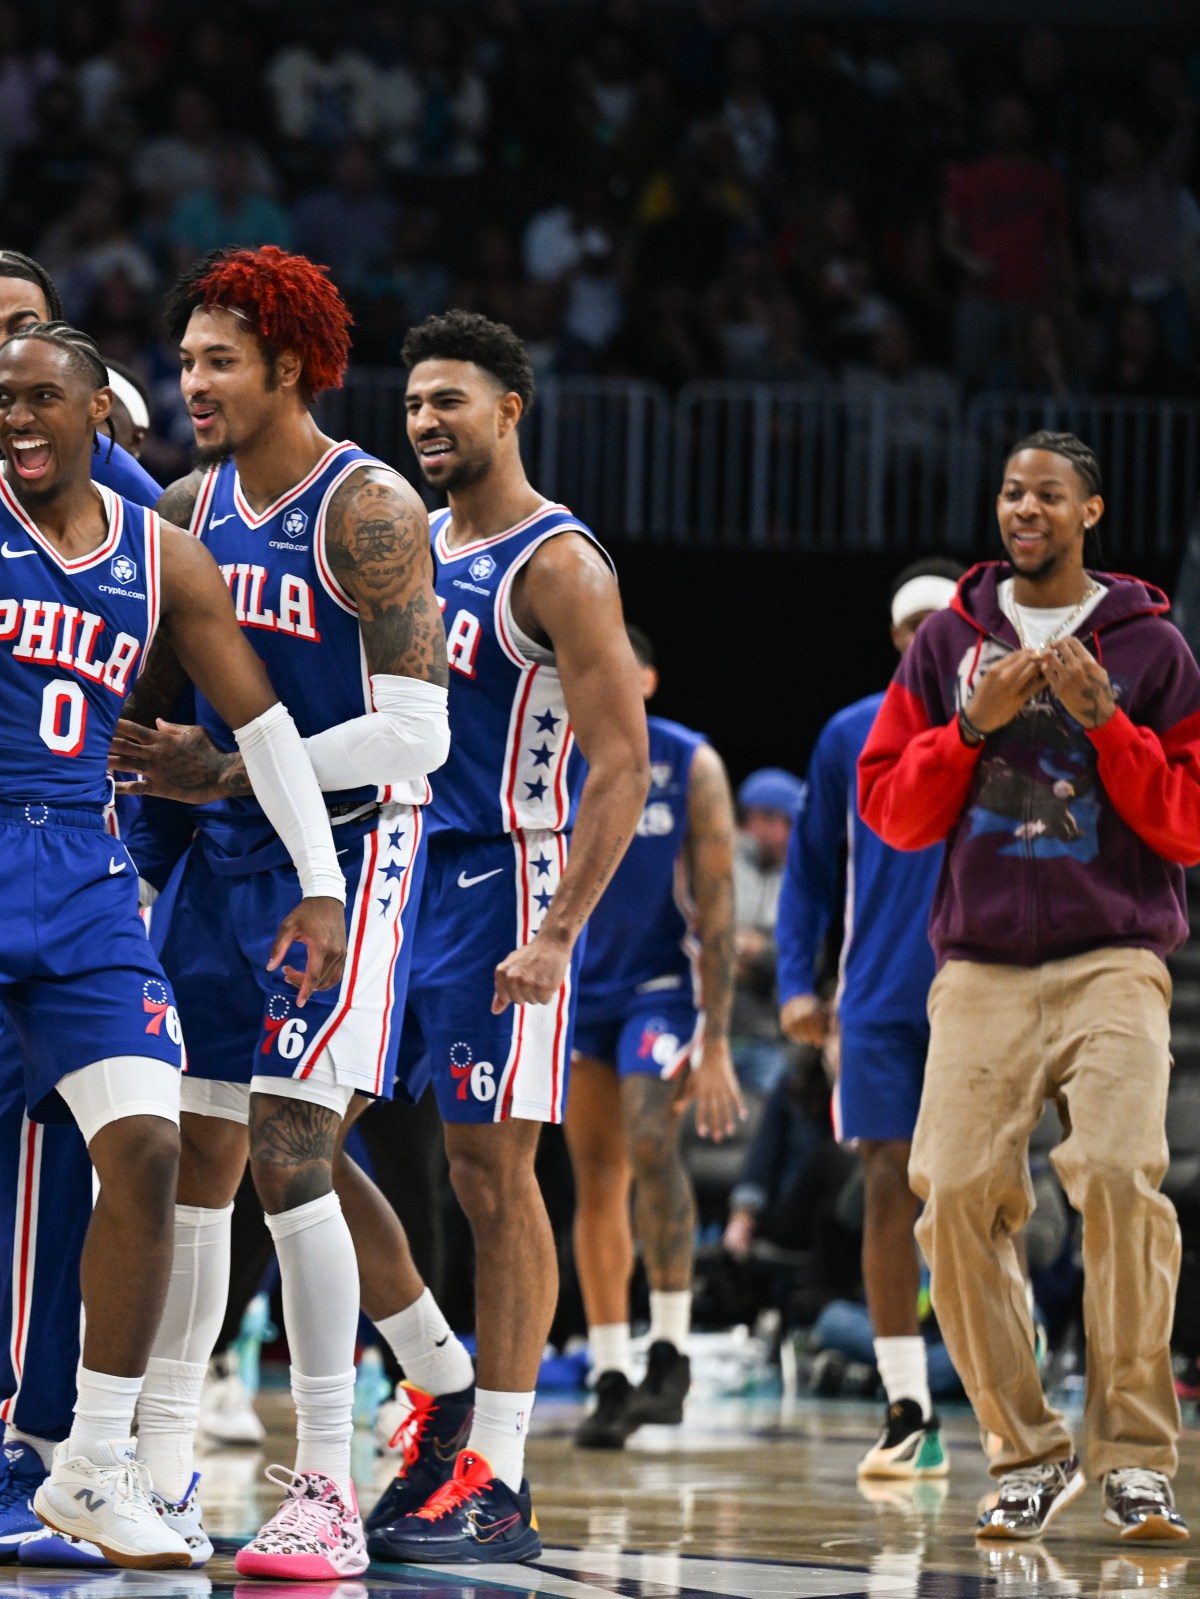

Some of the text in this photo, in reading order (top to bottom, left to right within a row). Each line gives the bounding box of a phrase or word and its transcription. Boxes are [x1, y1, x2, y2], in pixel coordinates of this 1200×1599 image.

[98, 584, 146, 601] crypto.com
[39, 678, 88, 758] 0
[142, 996, 183, 1046] 76
[261, 1015, 308, 1060] 76
[450, 1061, 496, 1102] 76
